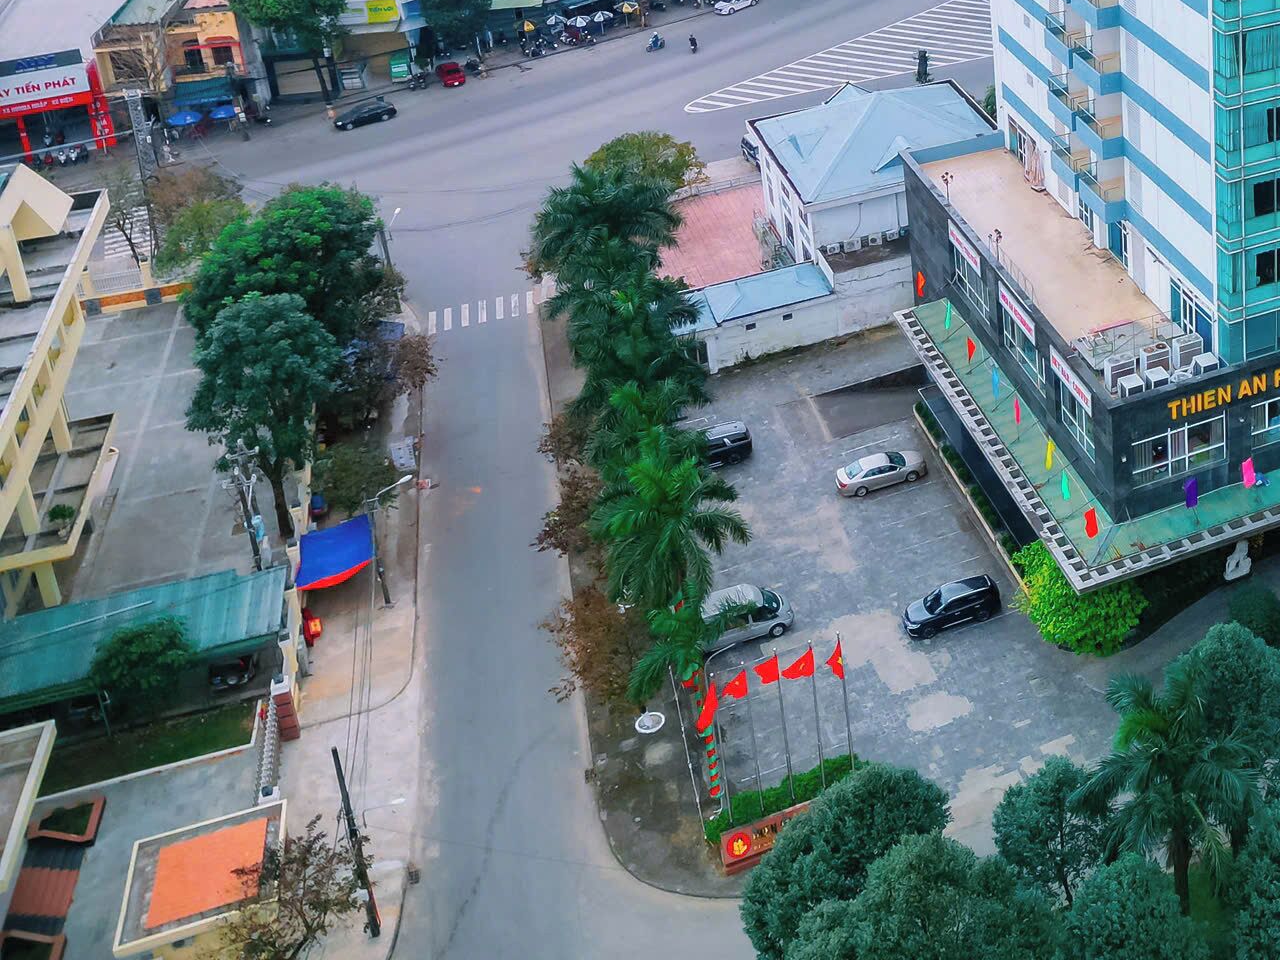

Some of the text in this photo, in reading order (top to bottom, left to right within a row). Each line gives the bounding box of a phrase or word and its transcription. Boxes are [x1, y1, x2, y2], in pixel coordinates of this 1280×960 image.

[14, 81, 41, 95] TIẾN
[44, 75, 76, 90] PHÁT
[1167, 386, 1232, 420] THIEN
[1237, 373, 1267, 400] AN
